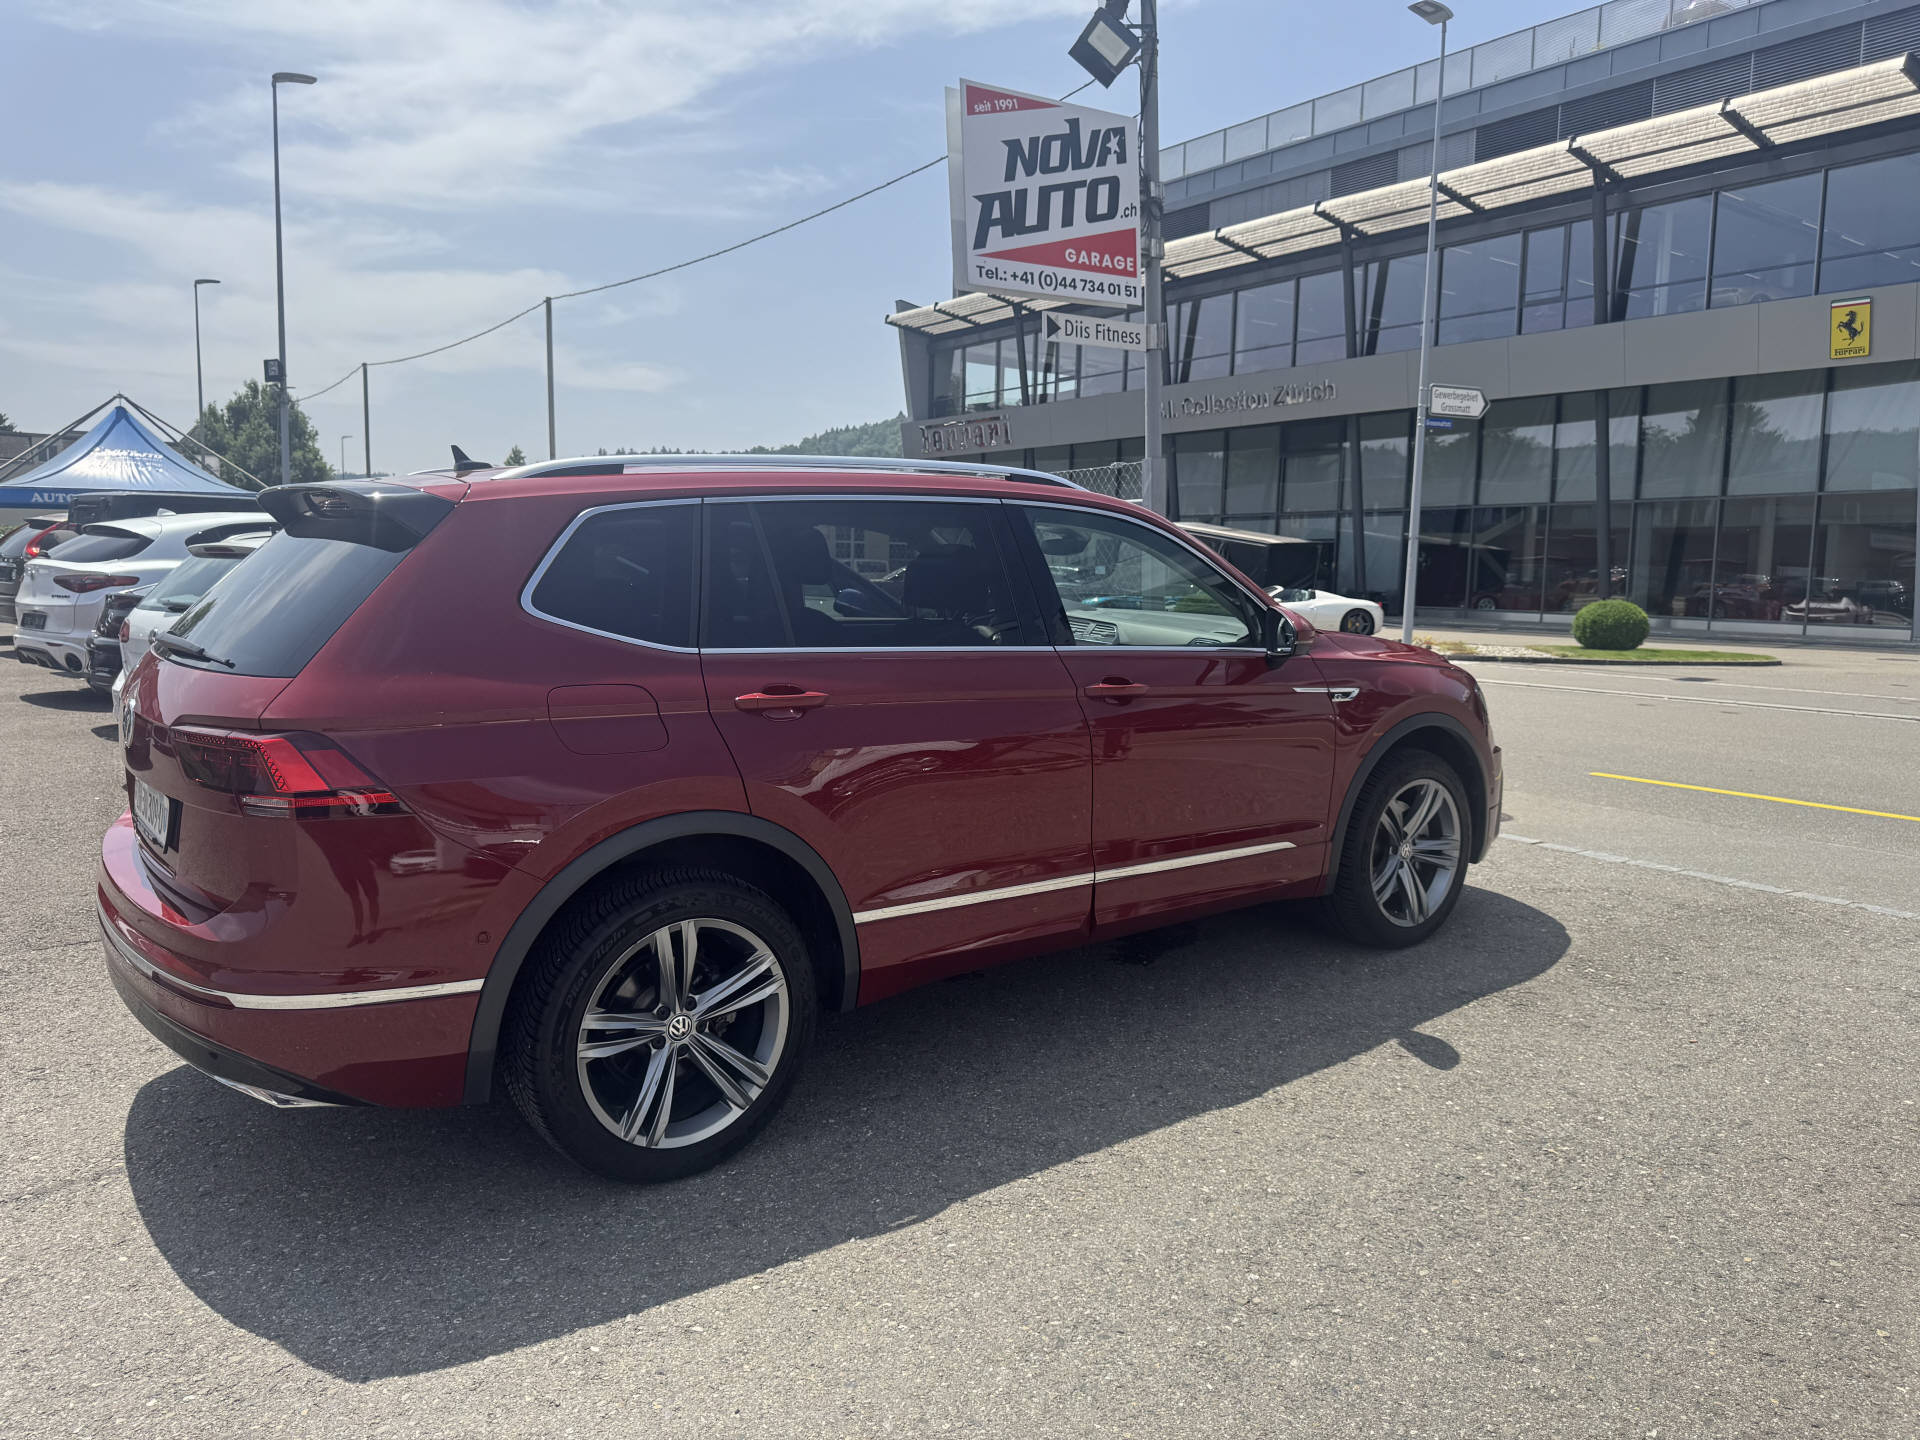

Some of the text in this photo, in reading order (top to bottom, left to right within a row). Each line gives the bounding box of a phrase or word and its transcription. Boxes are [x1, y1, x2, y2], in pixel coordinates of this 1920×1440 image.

[974, 98, 1019, 113] seit 1991
[1001, 117, 1127, 183] NOVA
[1064, 248, 1135, 272] GARAGE
[975, 264, 1008, 283] Tel.:
[1010, 271, 1035, 286] +41
[1079, 279, 1106, 294] 734
[1108, 281, 1121, 297] 01
[1124, 284, 1138, 299] 51
[1064, 319, 1142, 346] Diis Fitness
[1833, 345, 1866, 357] Ferrari
[1182, 389, 1269, 417] Collection
[1273, 378, 1338, 407] Zürich
